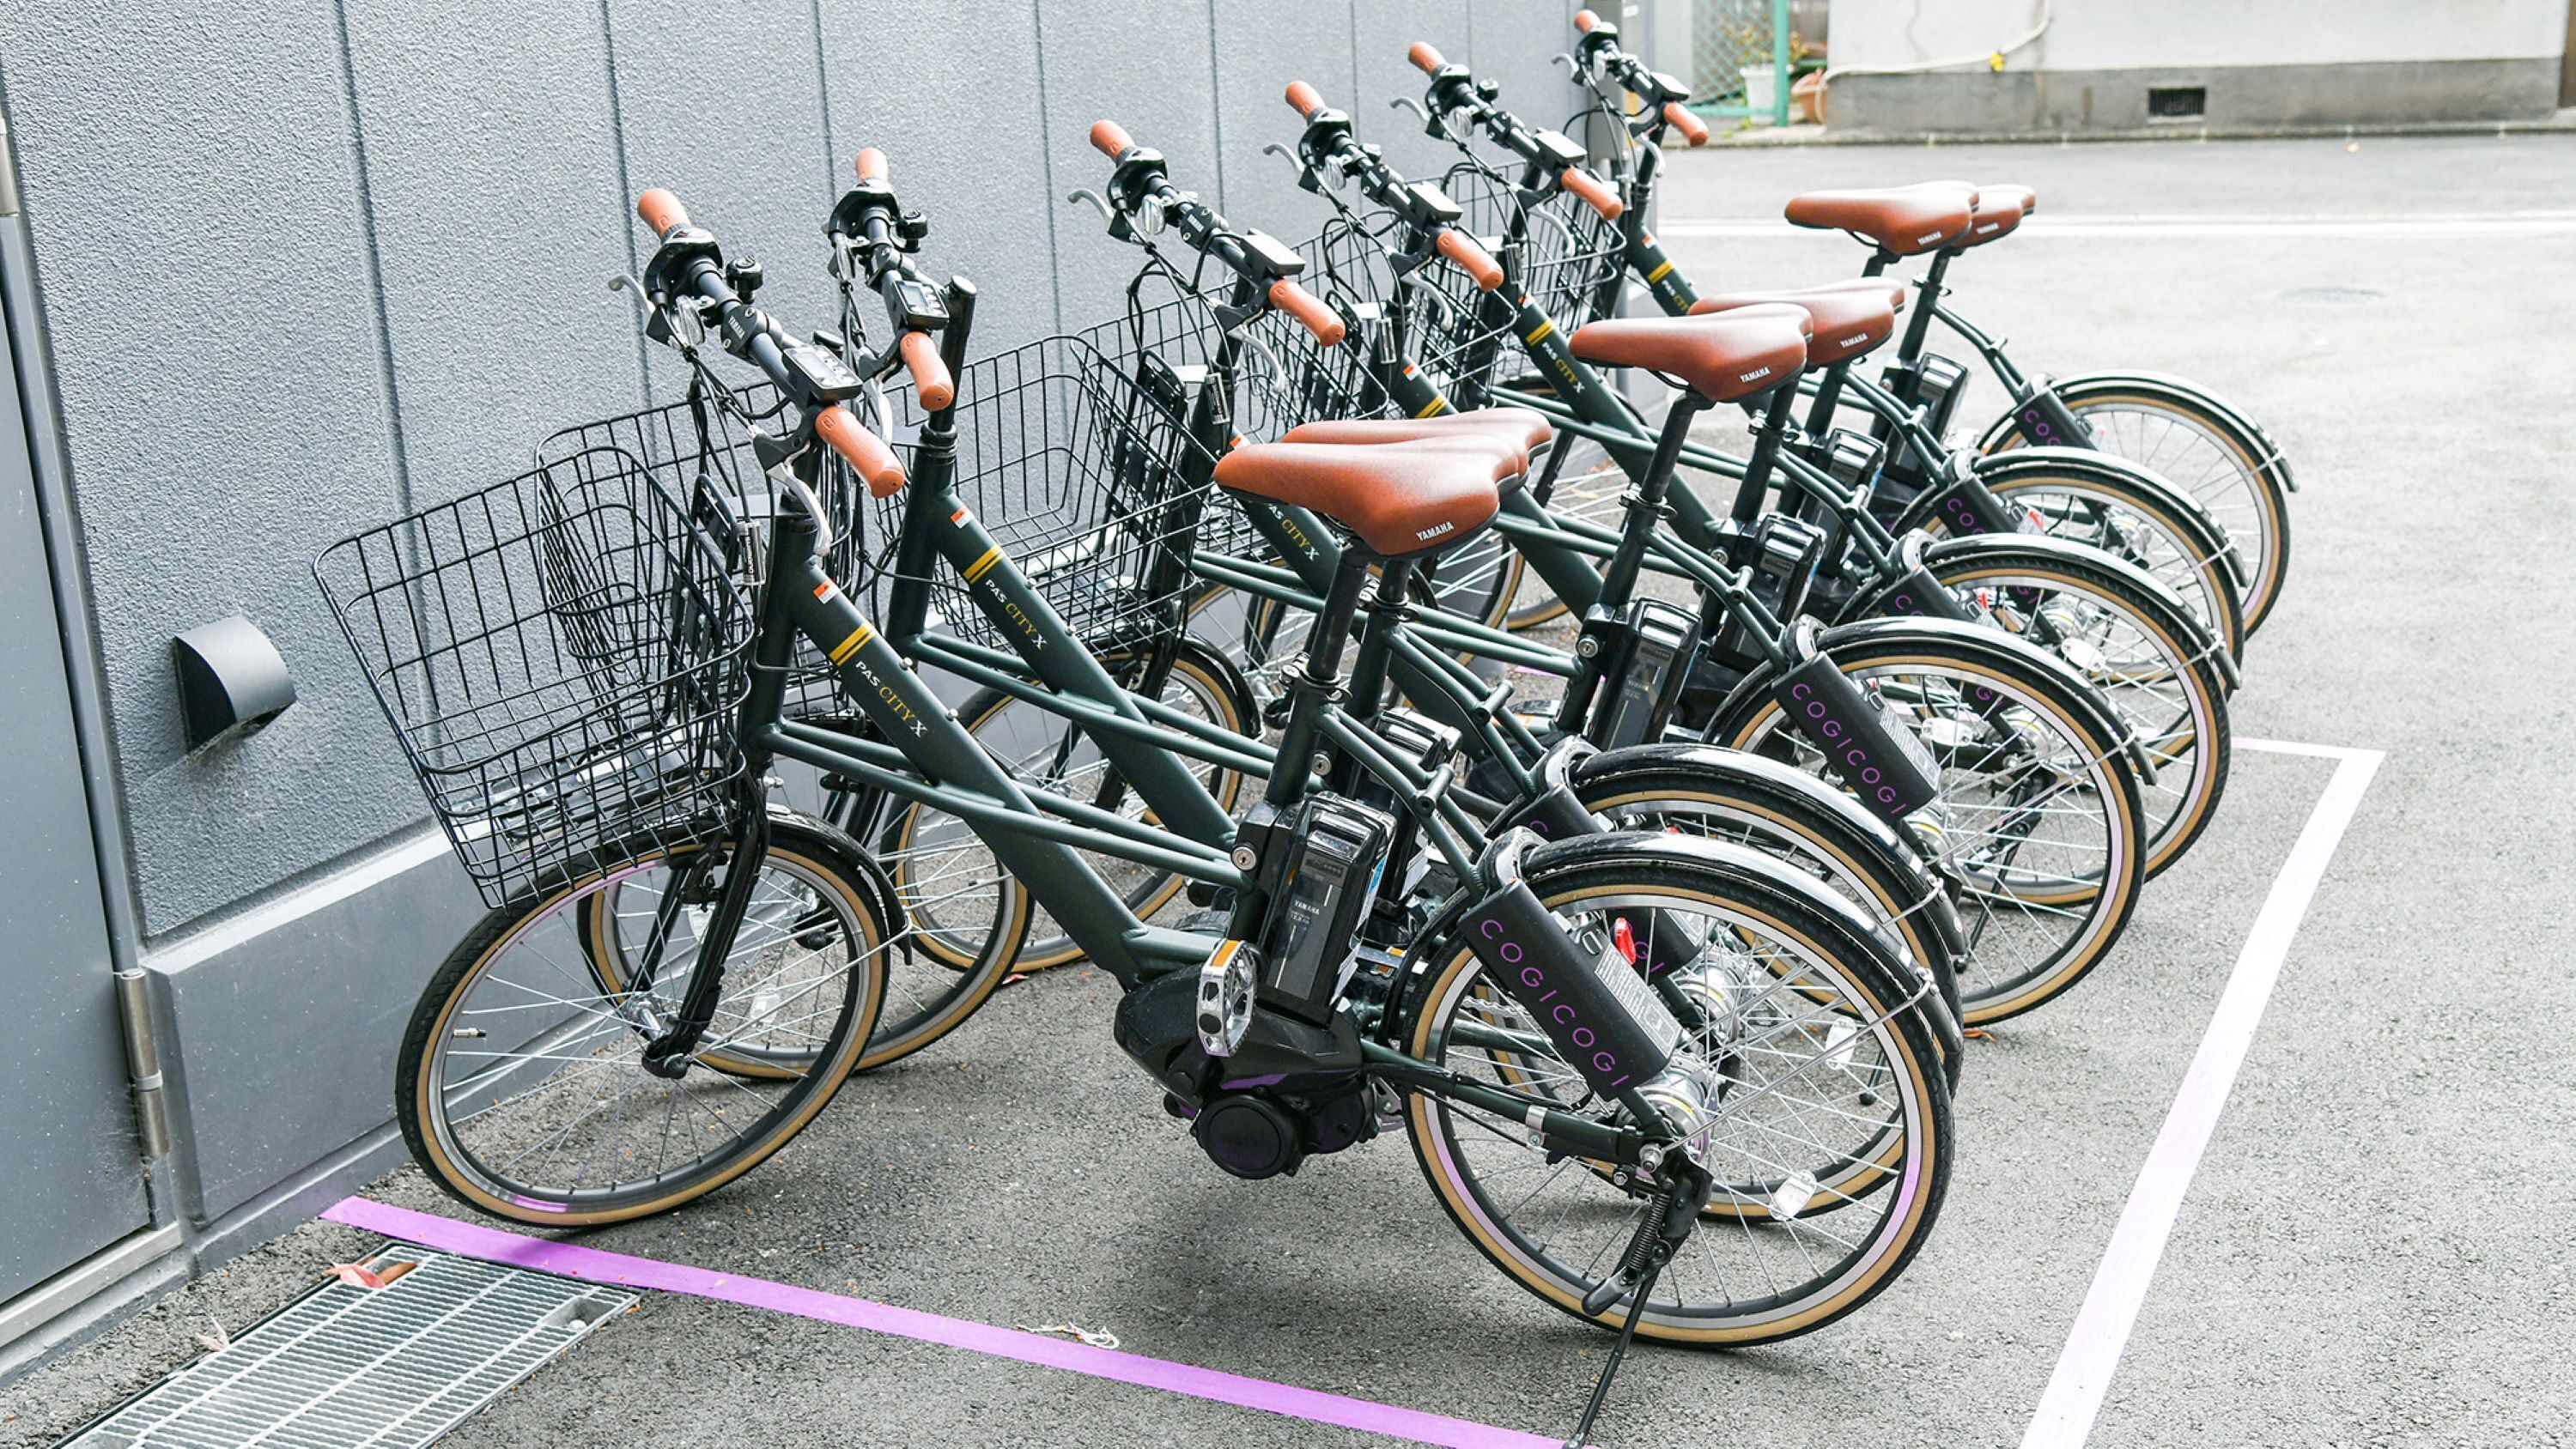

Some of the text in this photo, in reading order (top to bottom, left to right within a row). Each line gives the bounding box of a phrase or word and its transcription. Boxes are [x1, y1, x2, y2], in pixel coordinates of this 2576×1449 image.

[1541, 342, 1586, 394] PAS CITY X
[1839, 332, 1868, 349] YAMAHA
[1739, 366, 1771, 383] YAMAHA
[1267, 503, 1320, 561] AS CITY X
[1415, 520, 1455, 541] YAMAHA
[985, 579, 1048, 650] PAS CITY X
[855, 661, 927, 737] PAS CITY X
[1792, 683, 1907, 815] COGICOGI
[1294, 900, 1320, 915] YAMAHA
[1481, 919, 1629, 1087] COGICOGI
